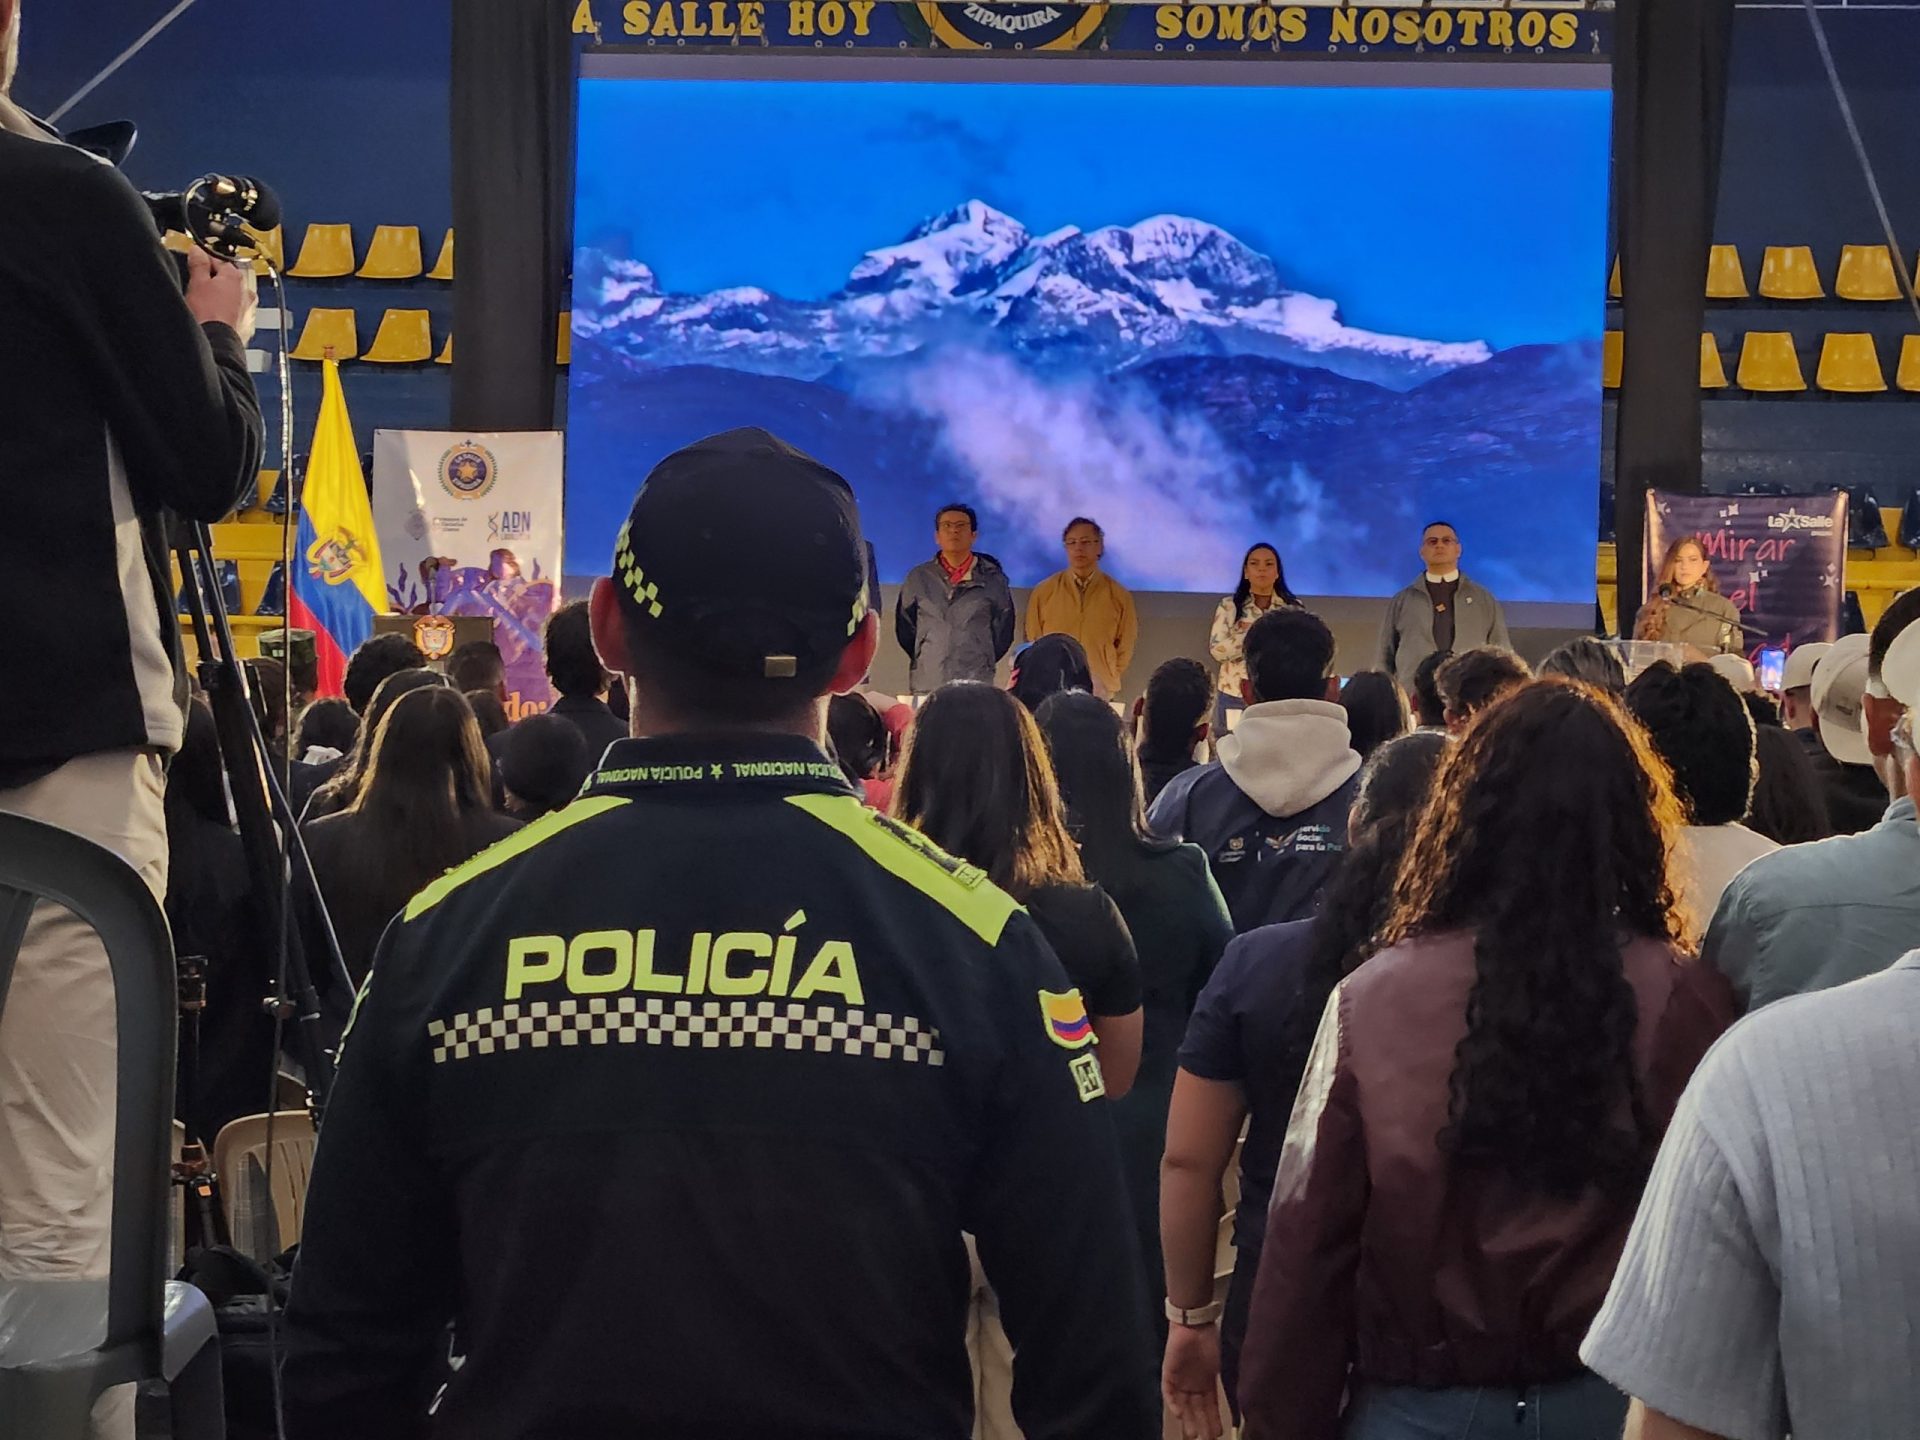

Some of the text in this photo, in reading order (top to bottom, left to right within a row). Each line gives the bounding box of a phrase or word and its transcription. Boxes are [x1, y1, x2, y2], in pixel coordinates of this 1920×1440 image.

[622, 0, 765, 36] SALLE
[788, 1, 871, 36] HOY
[963, 2, 1062, 34] ZIPAQUIRA
[1156, 5, 1579, 48] SOMOS NOSOTROS
[501, 511, 531, 533] ADN
[1767, 515, 1833, 528] La Salle
[1696, 528, 1796, 562] Mirar
[1728, 581, 1758, 612] el
[651, 765, 703, 784] POLICÍA
[731, 762, 805, 777] NACIONAL
[504, 909, 866, 1006] POLICÍA
